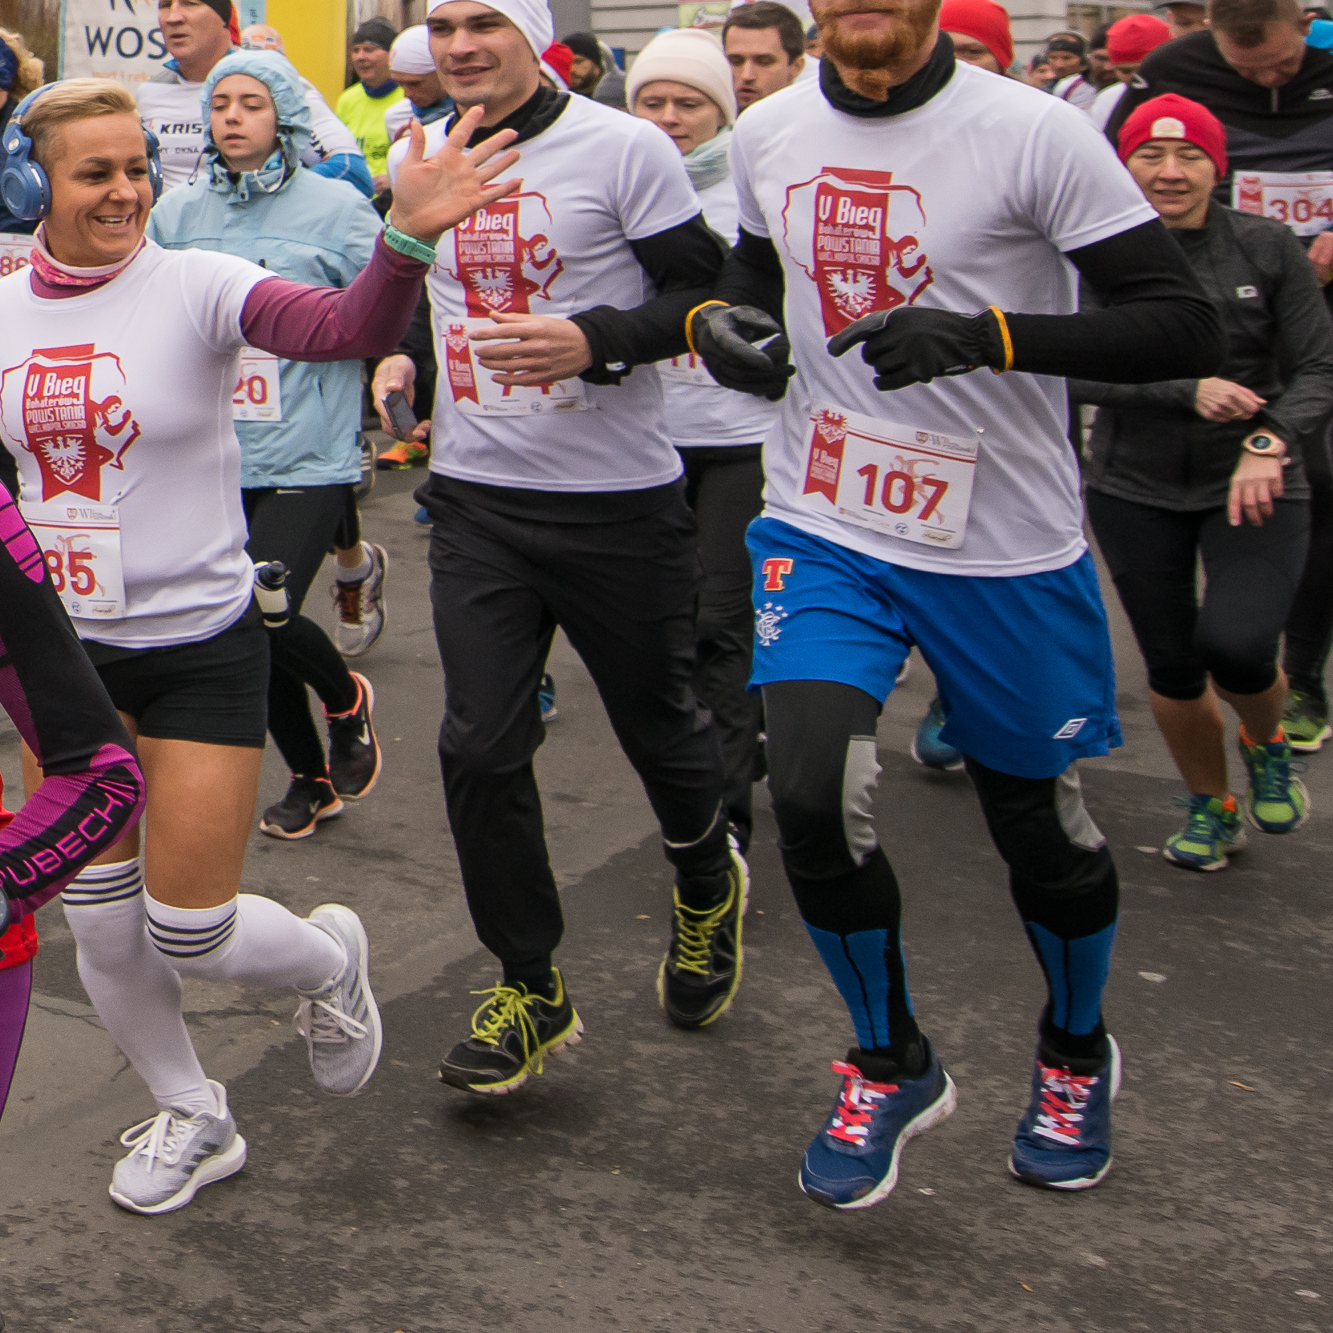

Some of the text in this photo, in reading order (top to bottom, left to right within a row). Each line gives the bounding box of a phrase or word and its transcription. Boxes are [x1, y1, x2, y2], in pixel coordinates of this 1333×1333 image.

[475, 208, 514, 239] Bieg
[819, 196, 883, 239] V Bieg
[26, 372, 86, 405] V Bieg
[856, 463, 950, 522] 107
[761, 557, 795, 593] T
